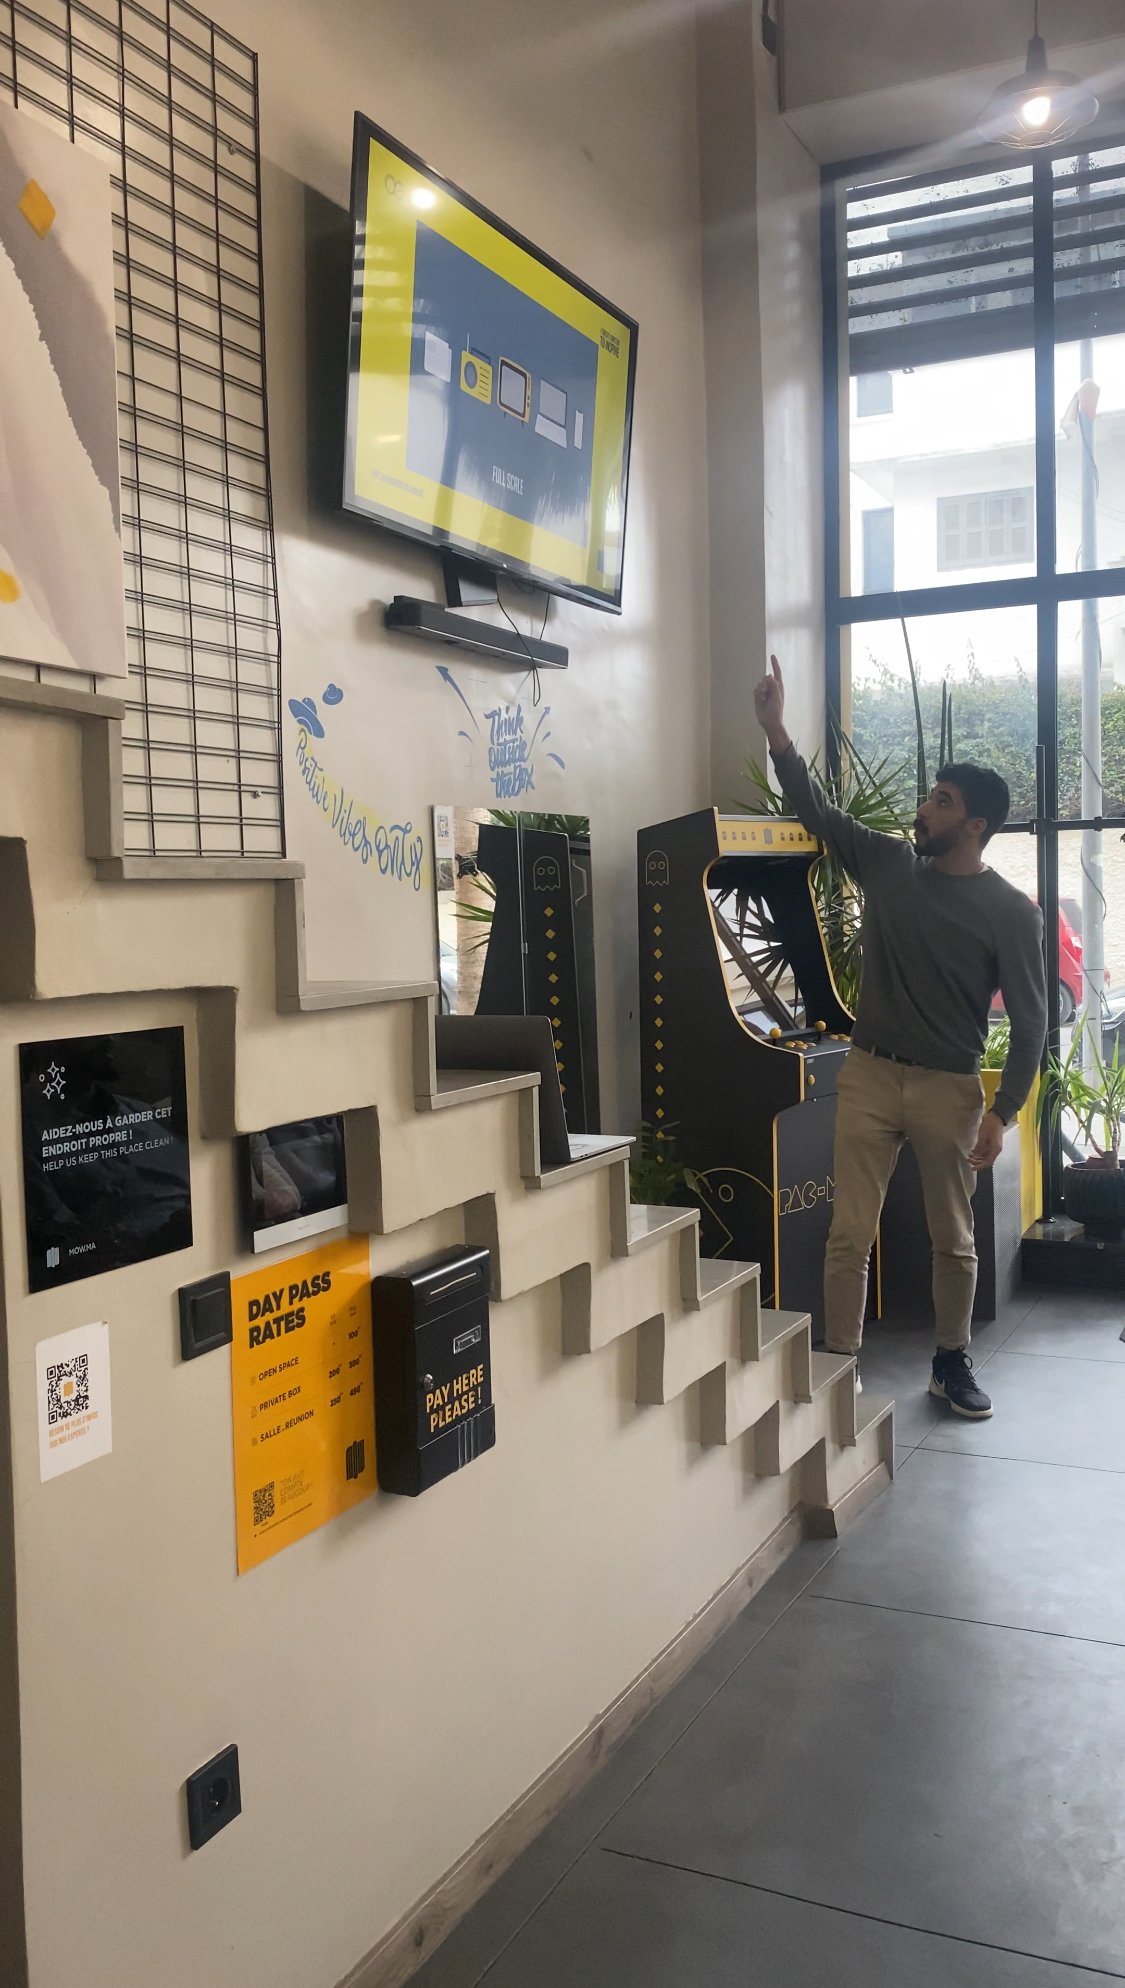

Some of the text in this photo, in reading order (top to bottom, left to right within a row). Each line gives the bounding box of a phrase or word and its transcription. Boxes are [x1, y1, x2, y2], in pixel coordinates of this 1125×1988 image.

[492, 465, 524, 495] FULL SCALE
[484, 704, 524, 746] Think
[296, 727, 330, 812] Positive
[332, 786, 372, 864] Vibes
[41, 1106, 172, 1142] AIDEZ-NOUS À GARDER CET
[42, 1130, 133, 1158] ENDROIT PROPRE !
[42, 1160, 64, 1172] HELP
[66, 1156, 77, 1167] US
[78, 1152, 99, 1165] KEEP
[101, 1148, 118, 1160] THIS
[120, 1142, 144, 1155] PLACE
[145, 1137, 170, 1150] CLEAN
[68, 1242, 96, 1256] MOW.MA
[248, 1271, 332, 1323] DAY PASS
[249, 1306, 306, 1349] RATES
[258, 1367, 277, 1381] OPEN
[279, 1356, 299, 1372] SPACE
[259, 1392, 286, 1412] PRIVATE
[288, 1385, 302, 1399] BOX
[426, 1363, 484, 1413] PAY HERE
[260, 1425, 281, 1442] SALLE
[284, 1409, 314, 1430] RÉUNION
[430, 1386, 481, 1433] PLEASE !
